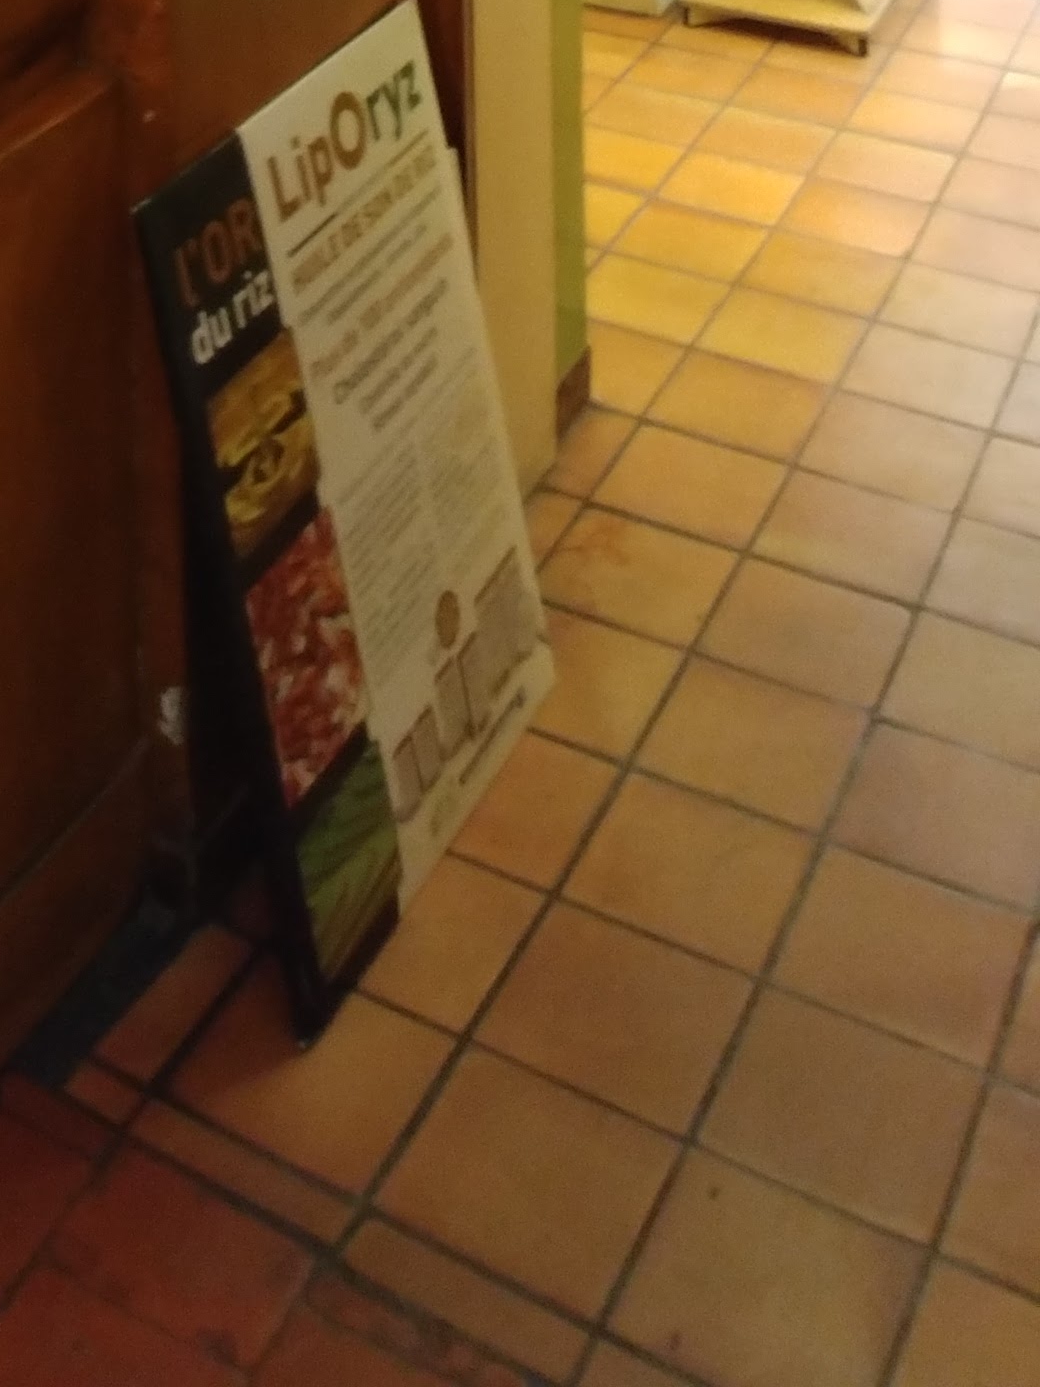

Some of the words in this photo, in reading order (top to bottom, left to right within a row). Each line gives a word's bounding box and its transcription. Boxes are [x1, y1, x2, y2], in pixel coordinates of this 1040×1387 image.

[266, 59, 423, 222] LipOryz
[191, 308, 233, 365] du
[232, 269, 275, 329] riz
